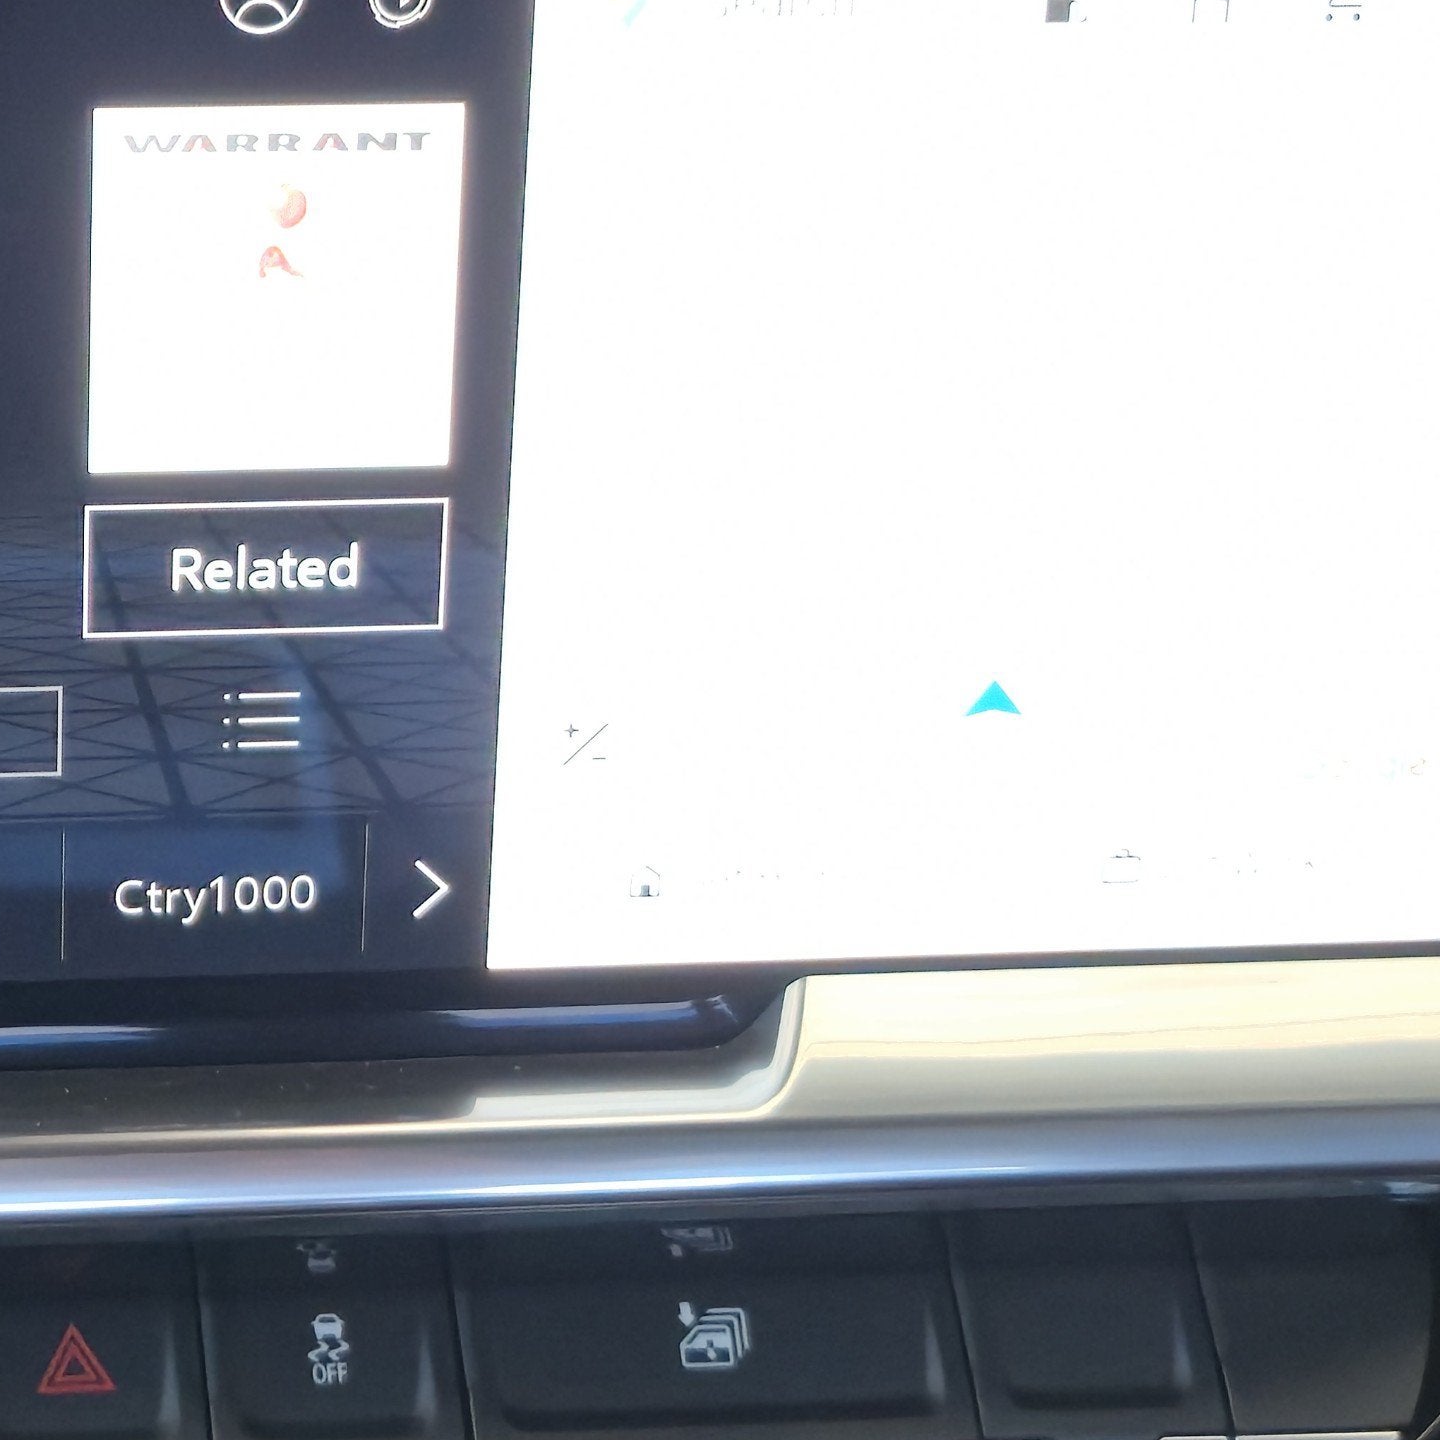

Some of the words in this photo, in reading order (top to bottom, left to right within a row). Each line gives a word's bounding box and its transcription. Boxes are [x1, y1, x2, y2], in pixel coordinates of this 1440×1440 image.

[124, 130, 433, 154] WARRANT
[171, 541, 361, 594] Related
[115, 874, 319, 926] Ctry1000
[312, 1362, 348, 1385] OFF
